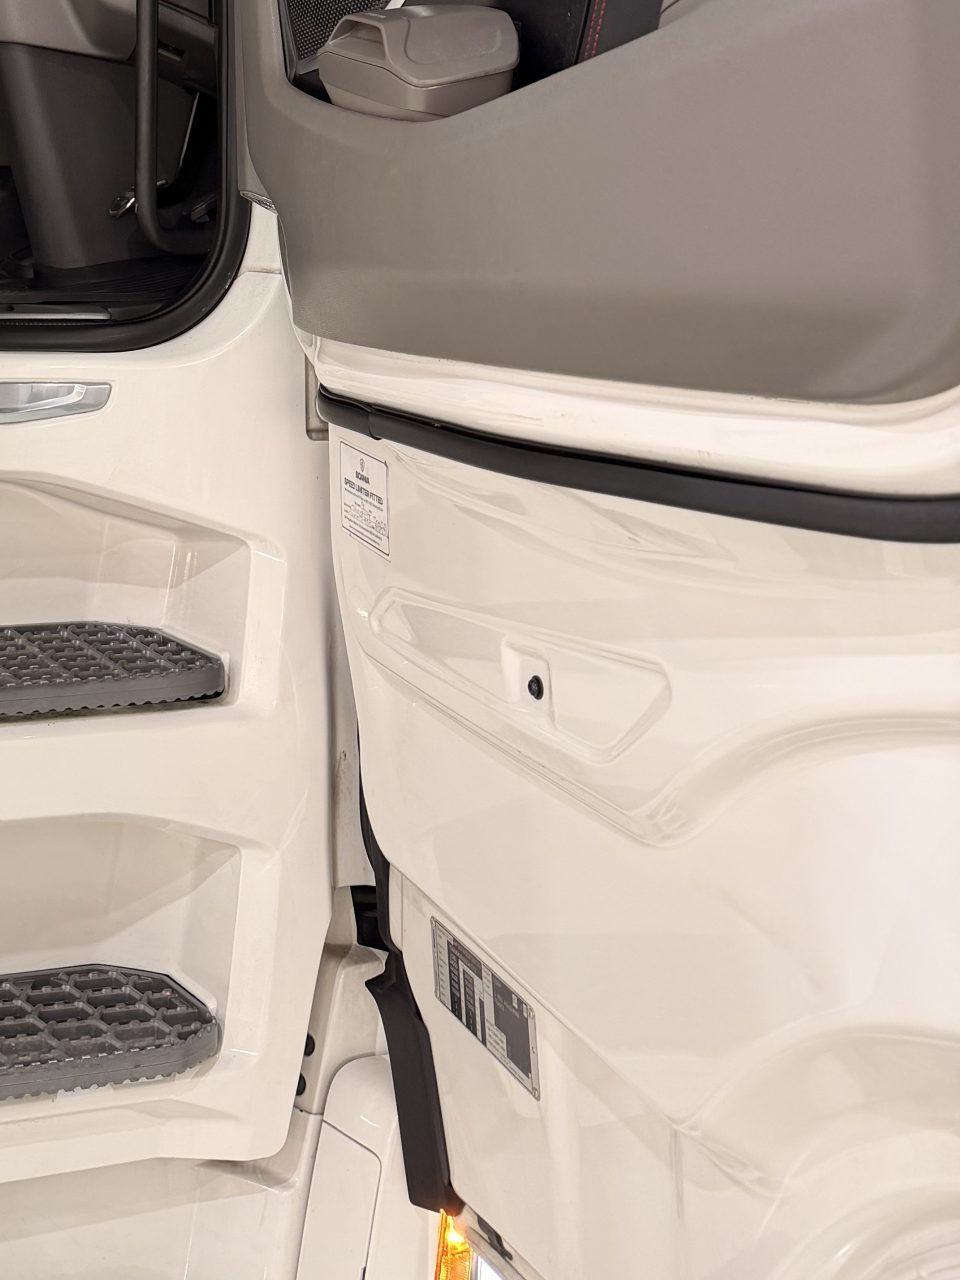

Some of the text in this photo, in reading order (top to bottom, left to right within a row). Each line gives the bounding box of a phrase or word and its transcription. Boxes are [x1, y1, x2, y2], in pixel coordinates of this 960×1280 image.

[355, 470, 370, 485] SCANIA
[344, 477, 356, 490] SPEED
[370, 492, 384, 505] FITTED
